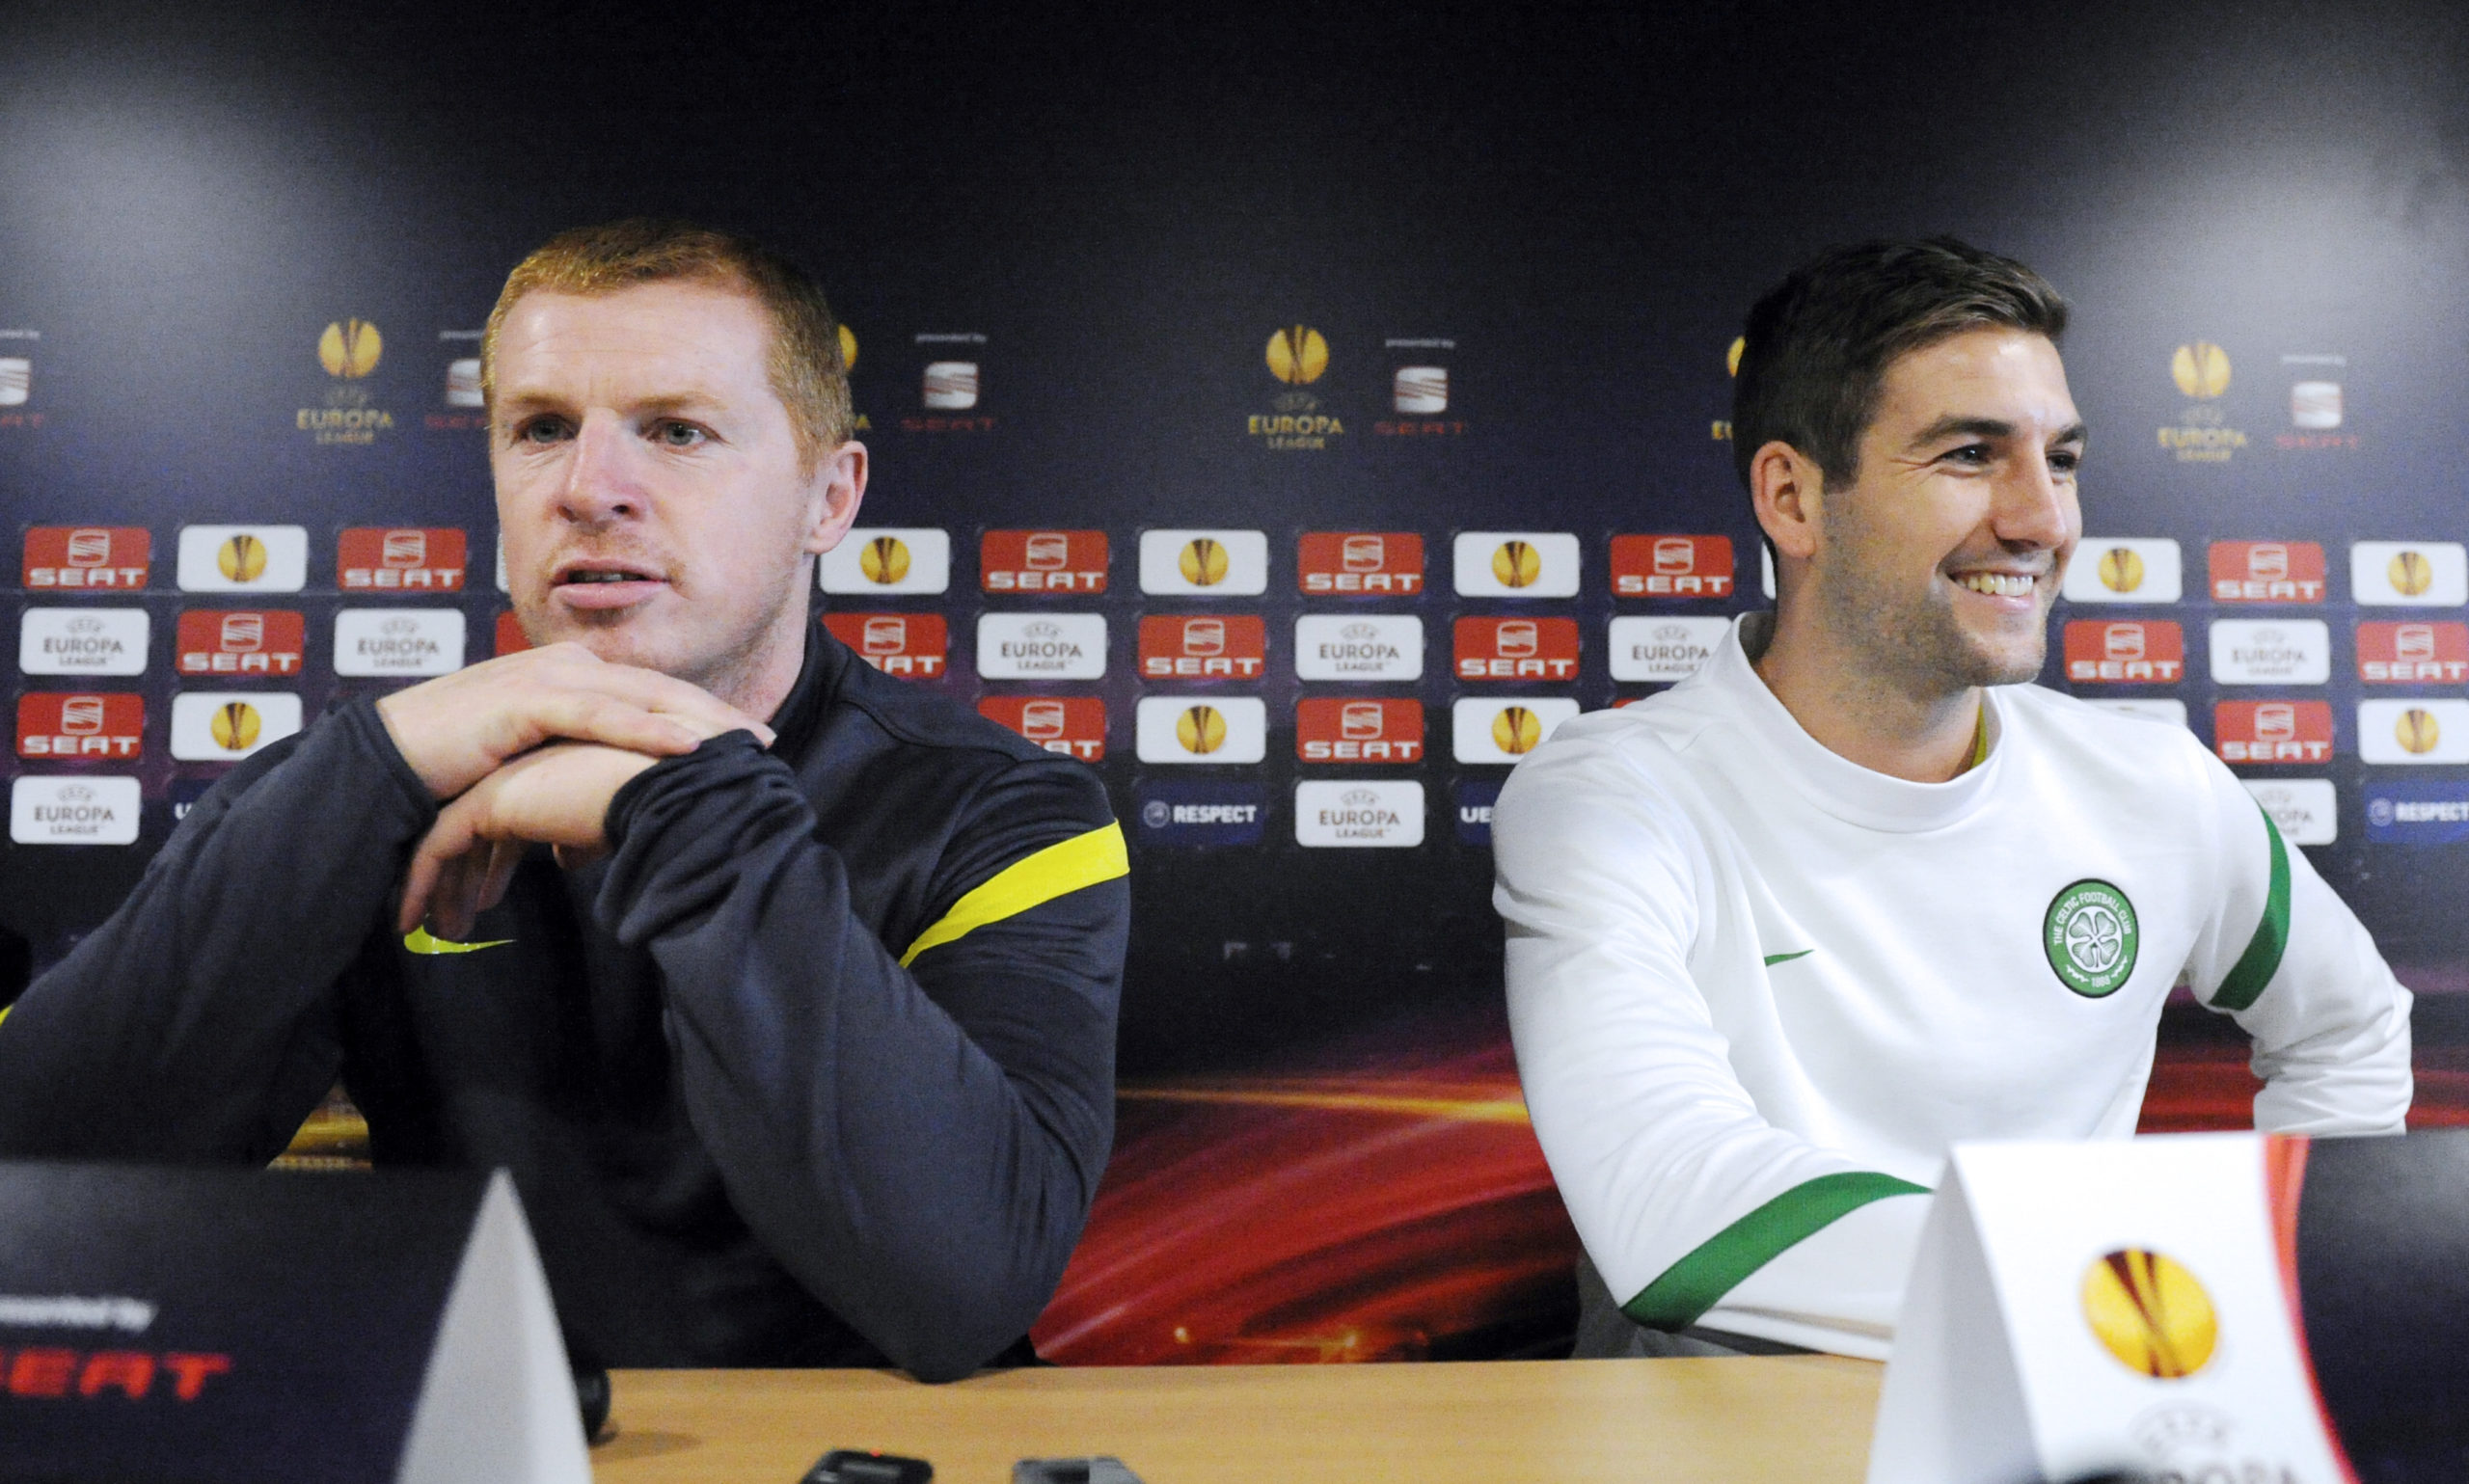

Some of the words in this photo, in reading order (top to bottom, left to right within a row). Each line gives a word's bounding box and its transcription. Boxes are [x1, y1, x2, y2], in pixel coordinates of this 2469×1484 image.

[296, 408, 393, 430] EUROPA
[1248, 416, 1343, 434] EUROPA
[29, 568, 146, 586] SEAT
[343, 568, 462, 588] SEAT
[988, 571, 1104, 590] SEAT
[1305, 573, 1421, 591] SEAT
[1617, 575, 1730, 593] SEAT
[2215, 580, 2321, 599] SEAT
[43, 637, 124, 655] EUROPA
[357, 637, 439, 656] EUROPA
[1001, 641, 1083, 658] EUROPA
[1318, 643, 1400, 660] EUROPA
[1632, 645, 1711, 661] EUROPA
[2231, 647, 2307, 663] EUROPA
[181, 652, 299, 672] SEAT
[1146, 657, 1262, 675] SEAT
[1459, 659, 1574, 677] SEAT
[2071, 660, 2181, 680] SEAT
[2363, 661, 2468, 680] SEAT
[23, 736, 139, 754] SEAT
[1304, 741, 1420, 759] SEAT
[2221, 741, 2328, 760] SEAT
[35, 805, 115, 822] EUROPA
[1173, 804, 1257, 823] RESPECT
[1318, 809, 1401, 825] EUROPA
[2078, 891, 2120, 912] FOOTBALL
[2055, 896, 2080, 926] CELTIC
[2118, 909, 2132, 934] CLUB
[2053, 926, 2063, 946] THE
[0, 1348, 233, 1400] EAT
